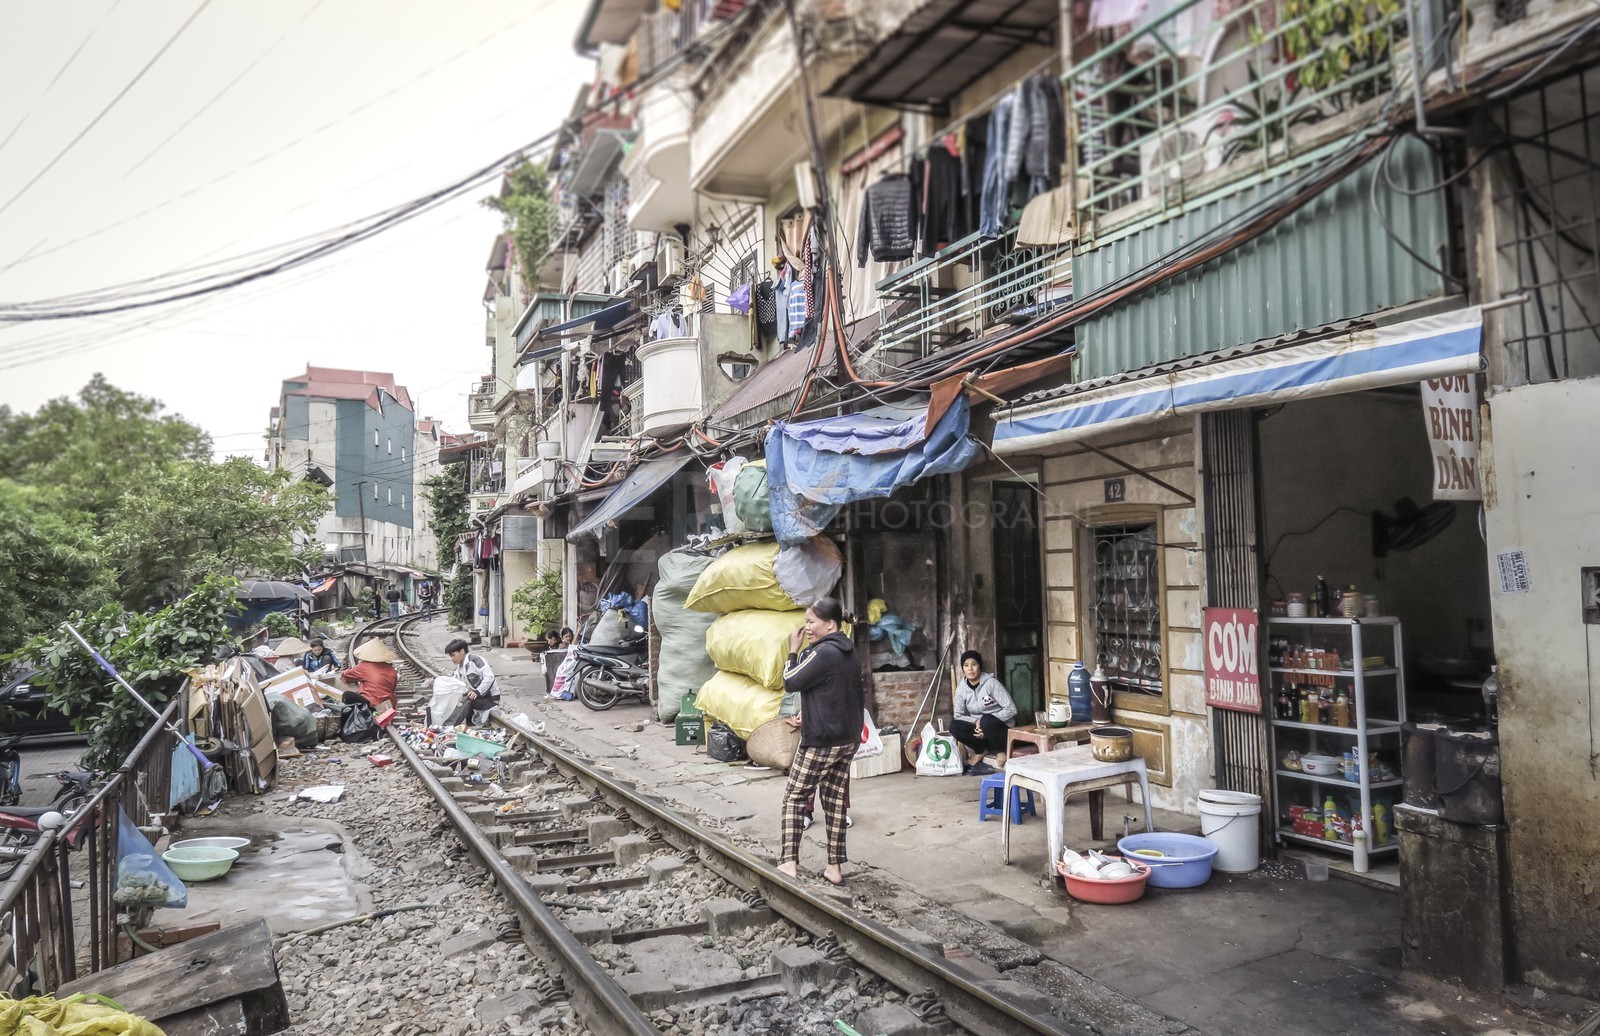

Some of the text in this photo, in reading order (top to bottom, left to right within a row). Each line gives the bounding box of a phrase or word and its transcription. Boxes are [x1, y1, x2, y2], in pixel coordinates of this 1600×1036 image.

[1428, 398, 1474, 442] BÌNH
[1436, 447, 1476, 490] DÂN
[1108, 483, 1122, 499] 42
[1208, 612, 1257, 675] CƠM
[1209, 673, 1258, 706] BÌNH DÂN
